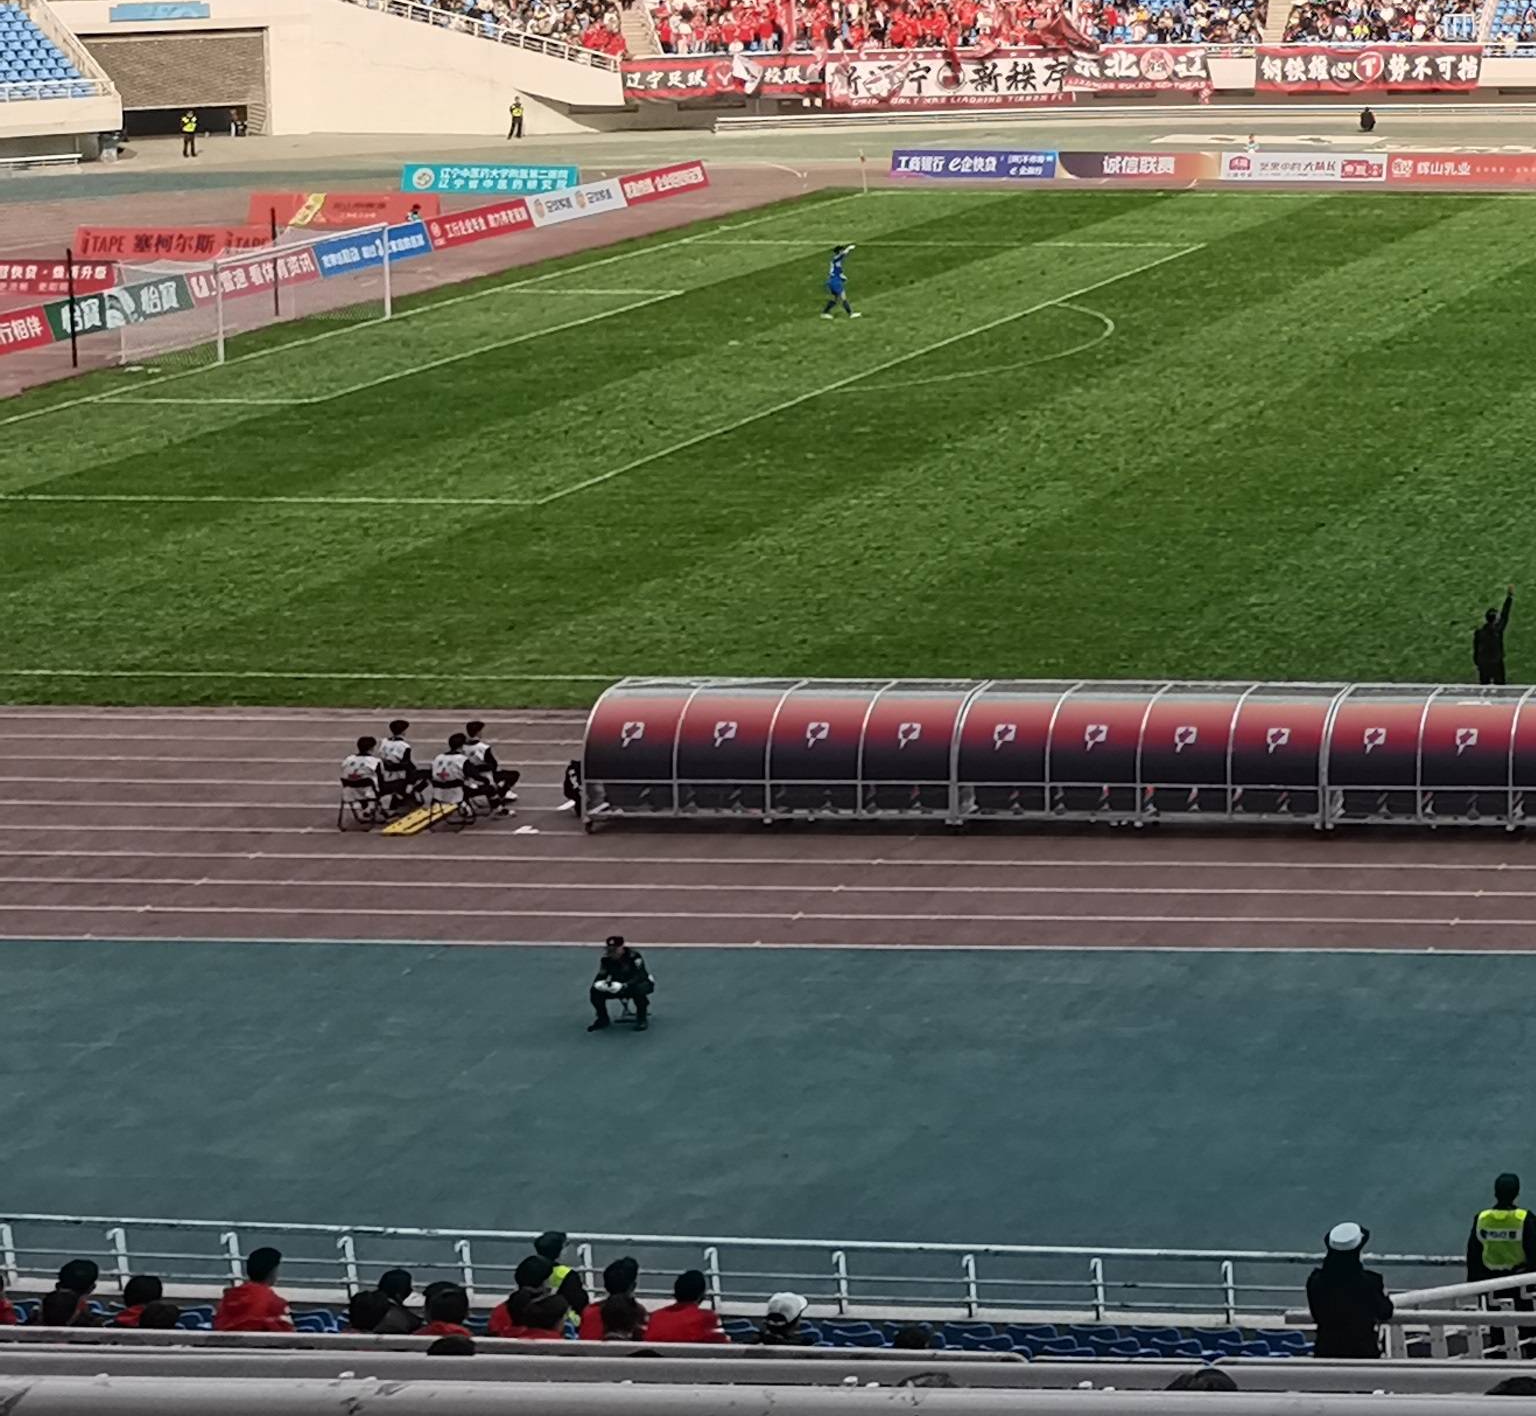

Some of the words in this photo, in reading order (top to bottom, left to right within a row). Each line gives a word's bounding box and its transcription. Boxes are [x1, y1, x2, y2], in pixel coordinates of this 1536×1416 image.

[625, 69, 708, 90] 辽宁足球
[1102, 155, 1175, 175] 诚信联赛
[1416, 160, 1471, 176] 辉山乳业
